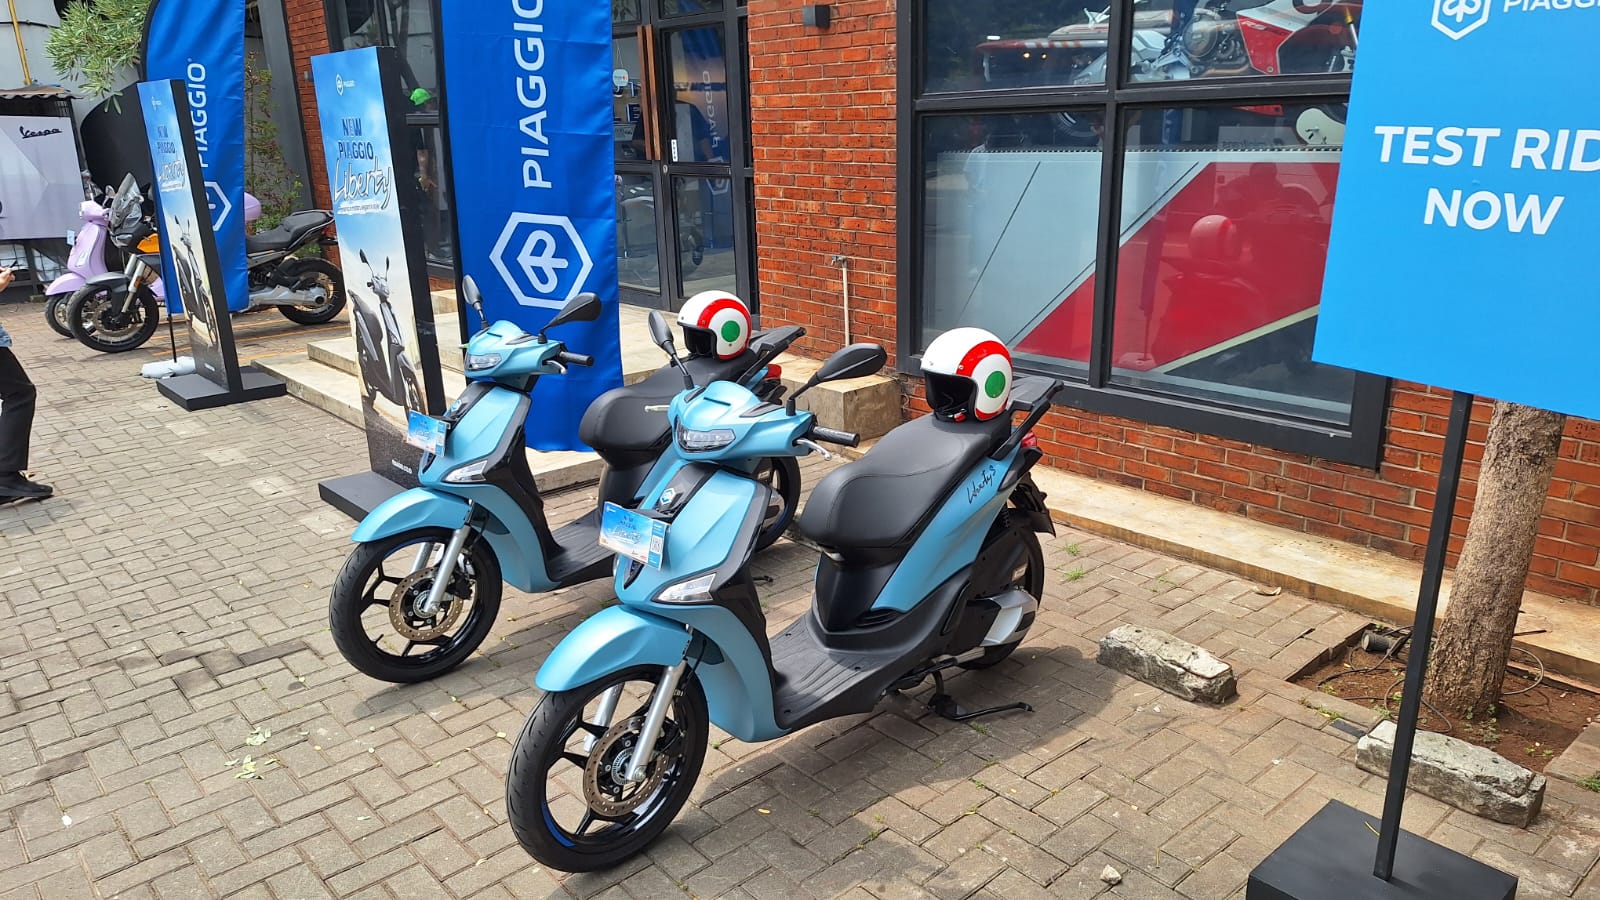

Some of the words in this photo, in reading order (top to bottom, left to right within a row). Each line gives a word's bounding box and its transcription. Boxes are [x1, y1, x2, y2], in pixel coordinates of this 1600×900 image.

[19, 125, 62, 139] Vespa
[342, 118, 362, 137] NEW
[338, 141, 374, 160] PIAGGIO
[1374, 125, 1501, 167] TEST
[1510, 128, 1600, 172] RID
[333, 156, 392, 210] Liberty
[1423, 187, 1565, 235] NOW
